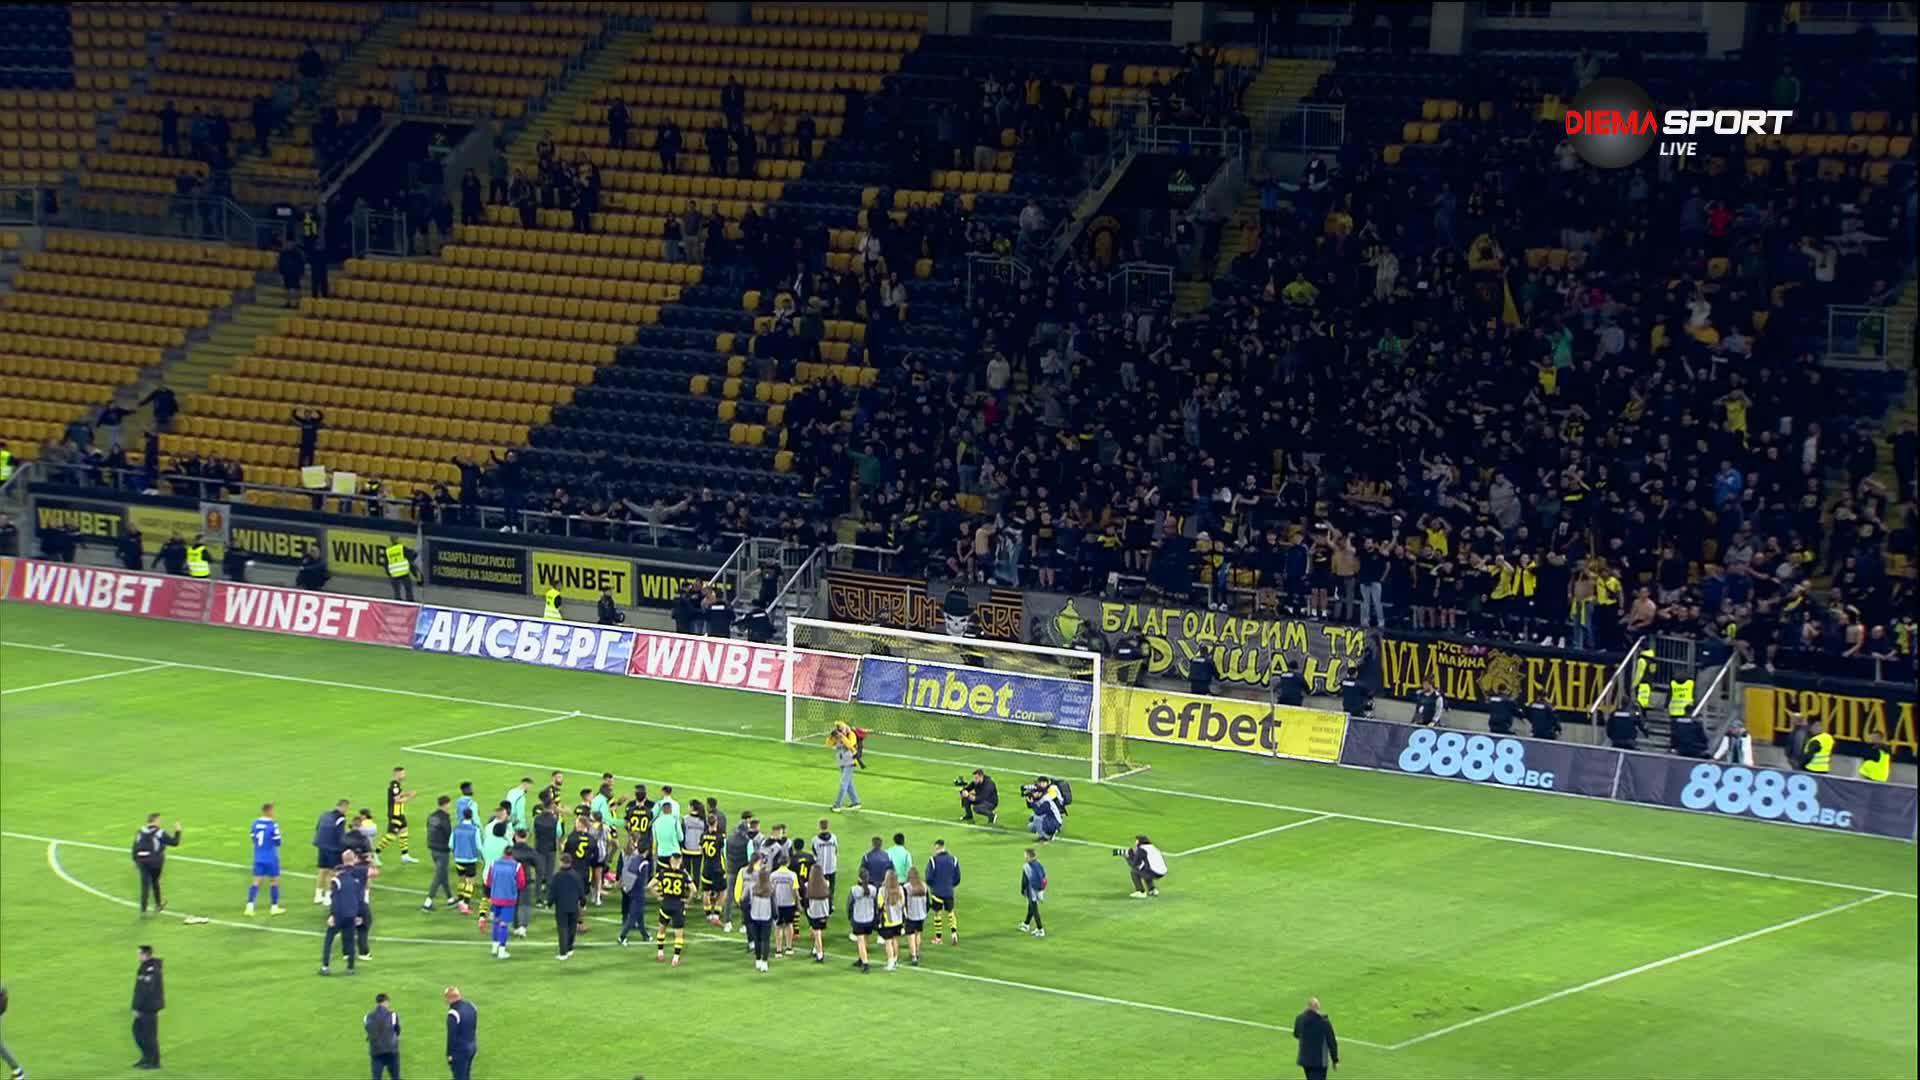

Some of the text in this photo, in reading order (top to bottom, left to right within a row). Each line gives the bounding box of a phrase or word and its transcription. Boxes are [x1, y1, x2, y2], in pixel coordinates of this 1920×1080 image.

[38, 507, 121, 537] WINBET
[332, 540, 387, 566] WINB
[23, 562, 163, 614] WINBET
[537, 563, 625, 594] WINBET
[225, 586, 369, 638] WINBET
[1100, 602, 1365, 658] БЛАГОДАРИМ ТИ
[646, 637, 804, 691] WINBET
[1438, 653, 1486, 668] МАЙНА
[630, 816, 648, 832] 20
[256, 830, 265, 847] 1
[575, 841, 589, 858] 5
[702, 841, 717, 857] 16
[663, 878, 682, 896] 28
